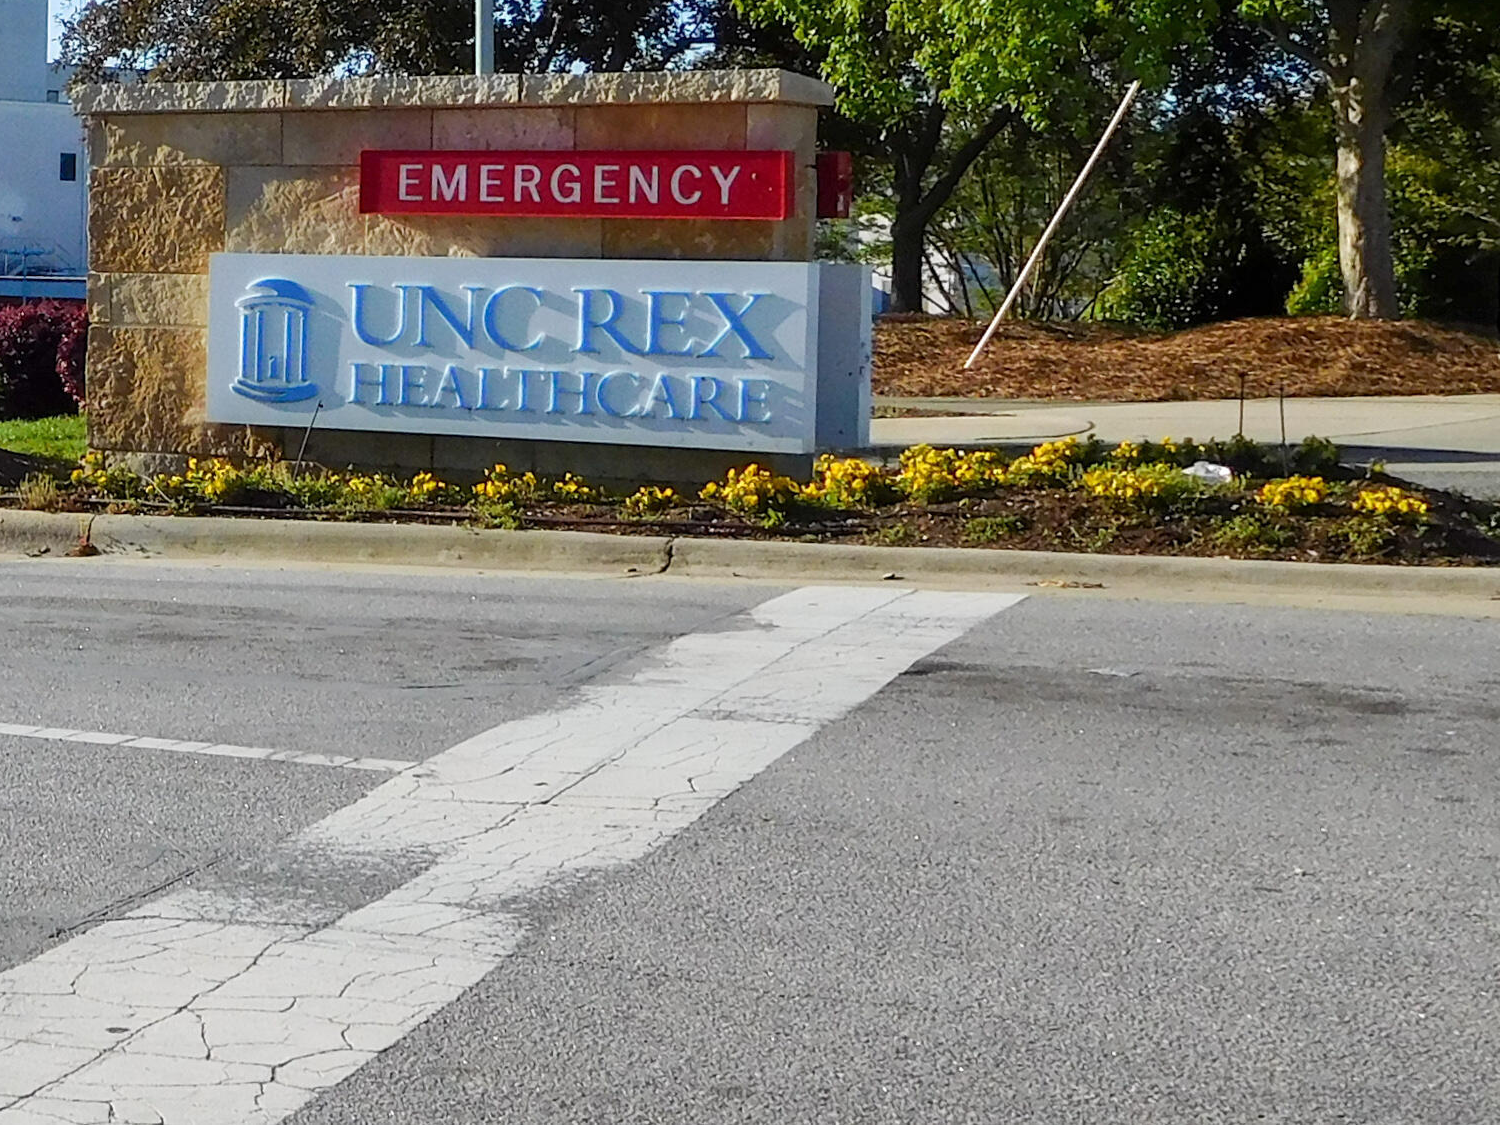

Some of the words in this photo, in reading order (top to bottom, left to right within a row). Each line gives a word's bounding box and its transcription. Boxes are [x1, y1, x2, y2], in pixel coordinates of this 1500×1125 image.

[398, 162, 741, 206] EMERGENCY
[346, 282, 543, 352] UNC
[570, 289, 774, 360] REX
[347, 363, 771, 423] HEALTHCARE
